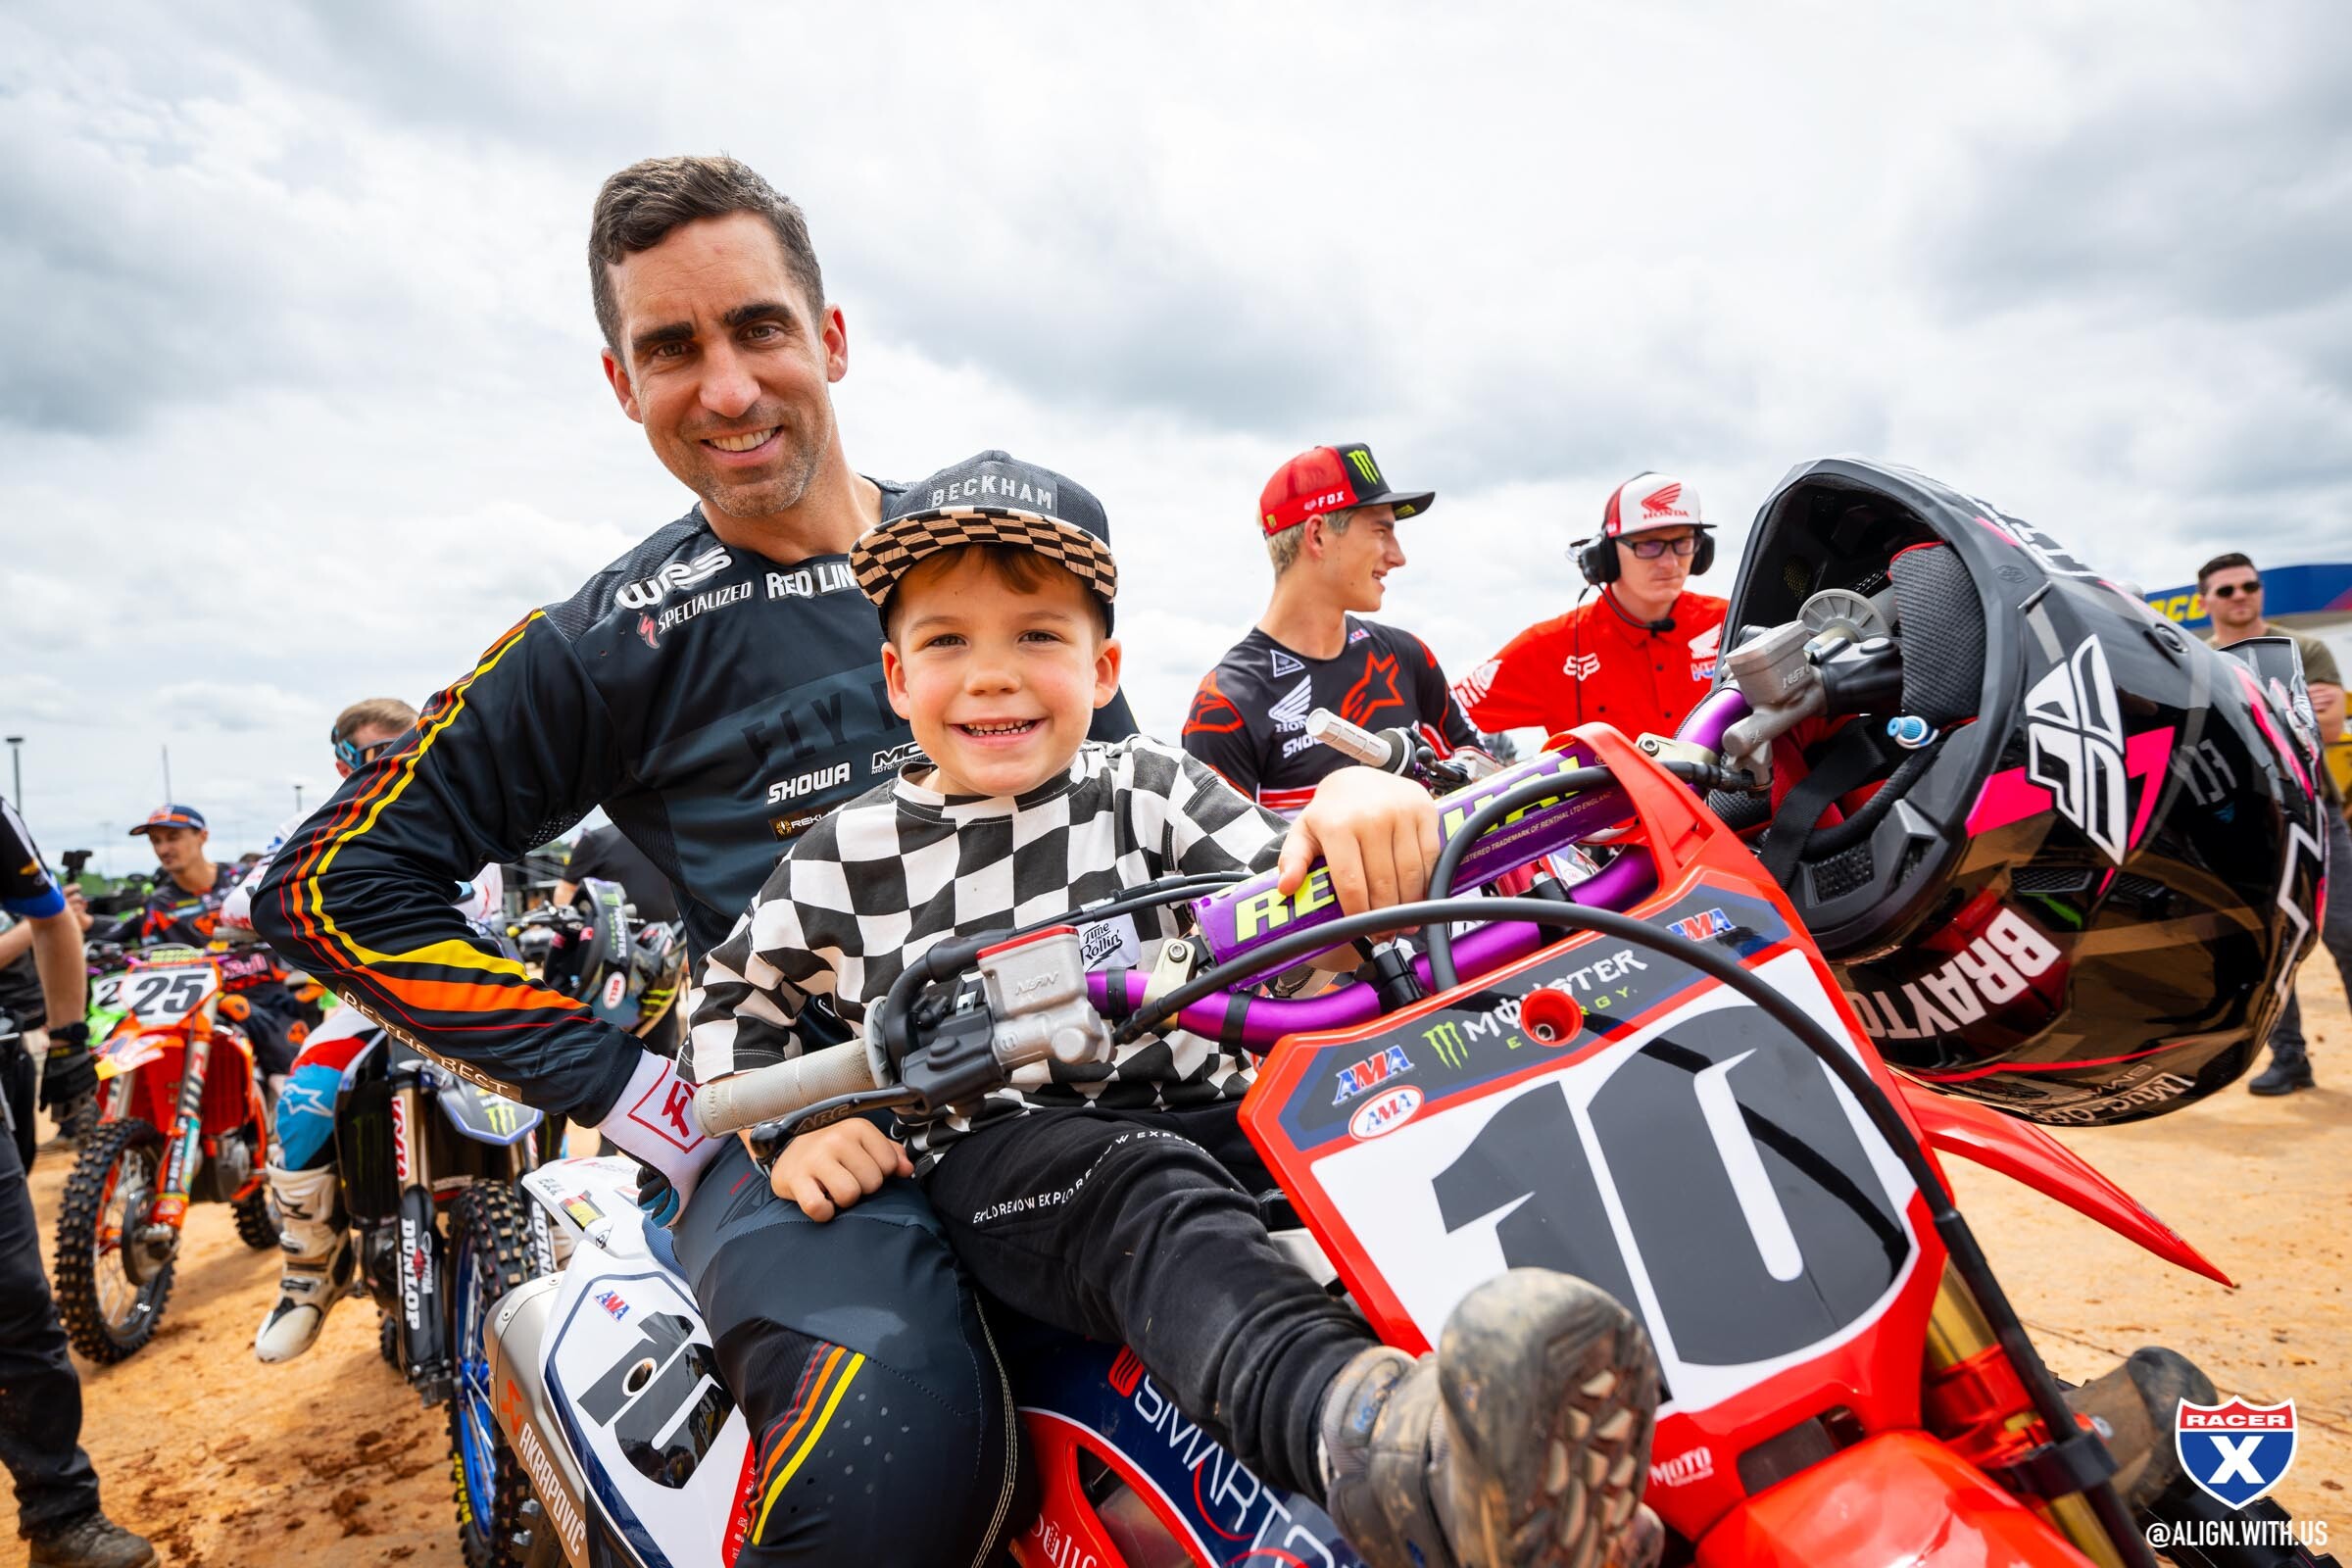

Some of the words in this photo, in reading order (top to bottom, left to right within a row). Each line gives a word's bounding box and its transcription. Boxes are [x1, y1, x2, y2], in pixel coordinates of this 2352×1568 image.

[932, 475, 1052, 510] BECKHAM
[1318, 491, 1344, 508] FOX
[1642, 509, 1690, 520] HONDA
[766, 570, 813, 600] RED
[657, 581, 753, 635] SPECIALIZED
[741, 692, 848, 765] FLY
[1282, 734, 1325, 760] SHO
[767, 761, 851, 805] SHOWA
[1491, 829, 1532, 851] TRADEMARK
[1530, 823, 1541, 833] OF
[1540, 811, 1570, 829] RENTHAL
[1570, 805, 1583, 815] LTD
[1665, 907, 1737, 942] AMA
[131, 973, 208, 1017] 25
[1461, 949, 1648, 1043] MOSTER
[343, 991, 379, 1017] BE
[378, 1023, 432, 1058] THE
[1332, 1045, 1415, 1106] AMA
[1366, 1093, 1412, 1132] AMA
[1432, 1004, 1910, 1401] 10
[402, 1218, 420, 1331] DUNLOP
[593, 1290, 631, 1322] AMA
[1650, 1446, 1711, 1487] MOTO
